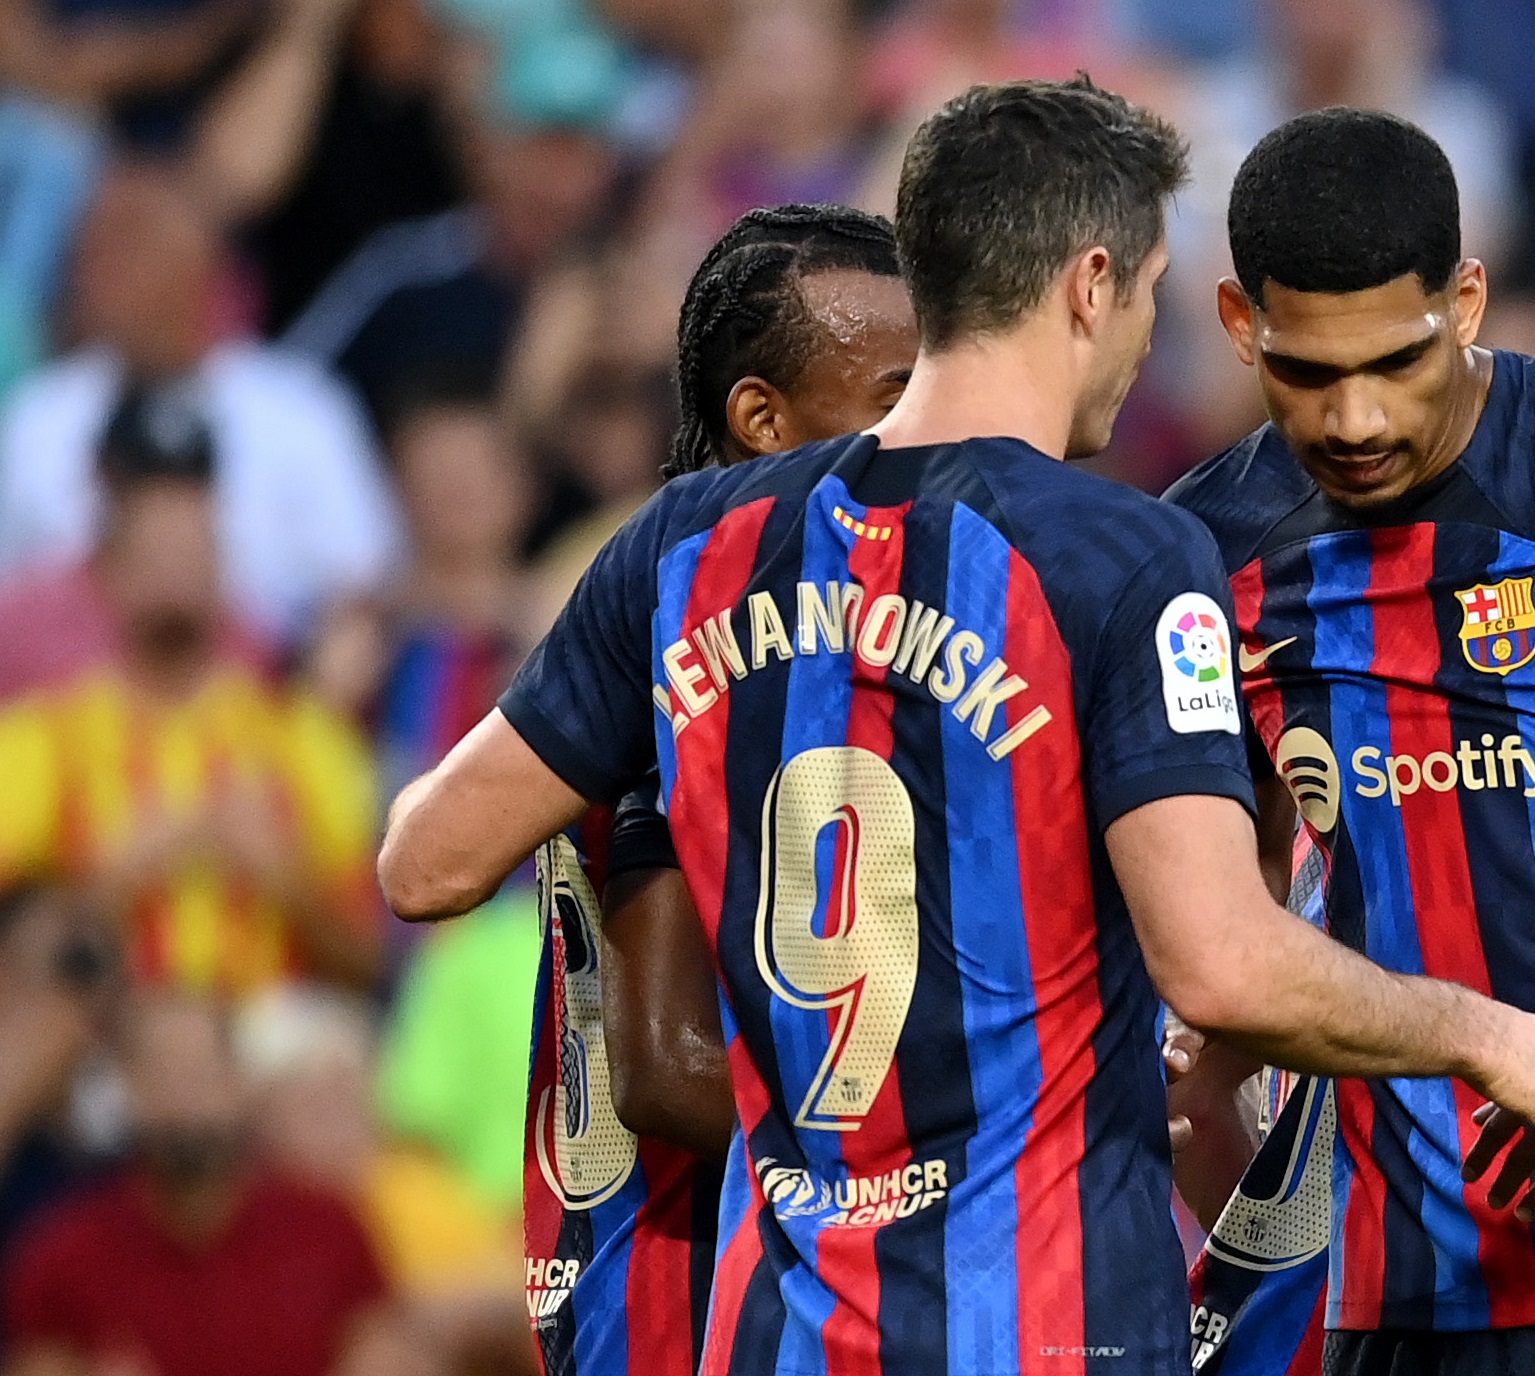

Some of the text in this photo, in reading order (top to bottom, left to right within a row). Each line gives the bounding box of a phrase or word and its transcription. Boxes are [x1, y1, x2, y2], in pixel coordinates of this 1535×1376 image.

[756, 747, 919, 1131] 9
[835, 1159, 949, 1209] UNHCR
[524, 1257, 580, 1288] HCR
